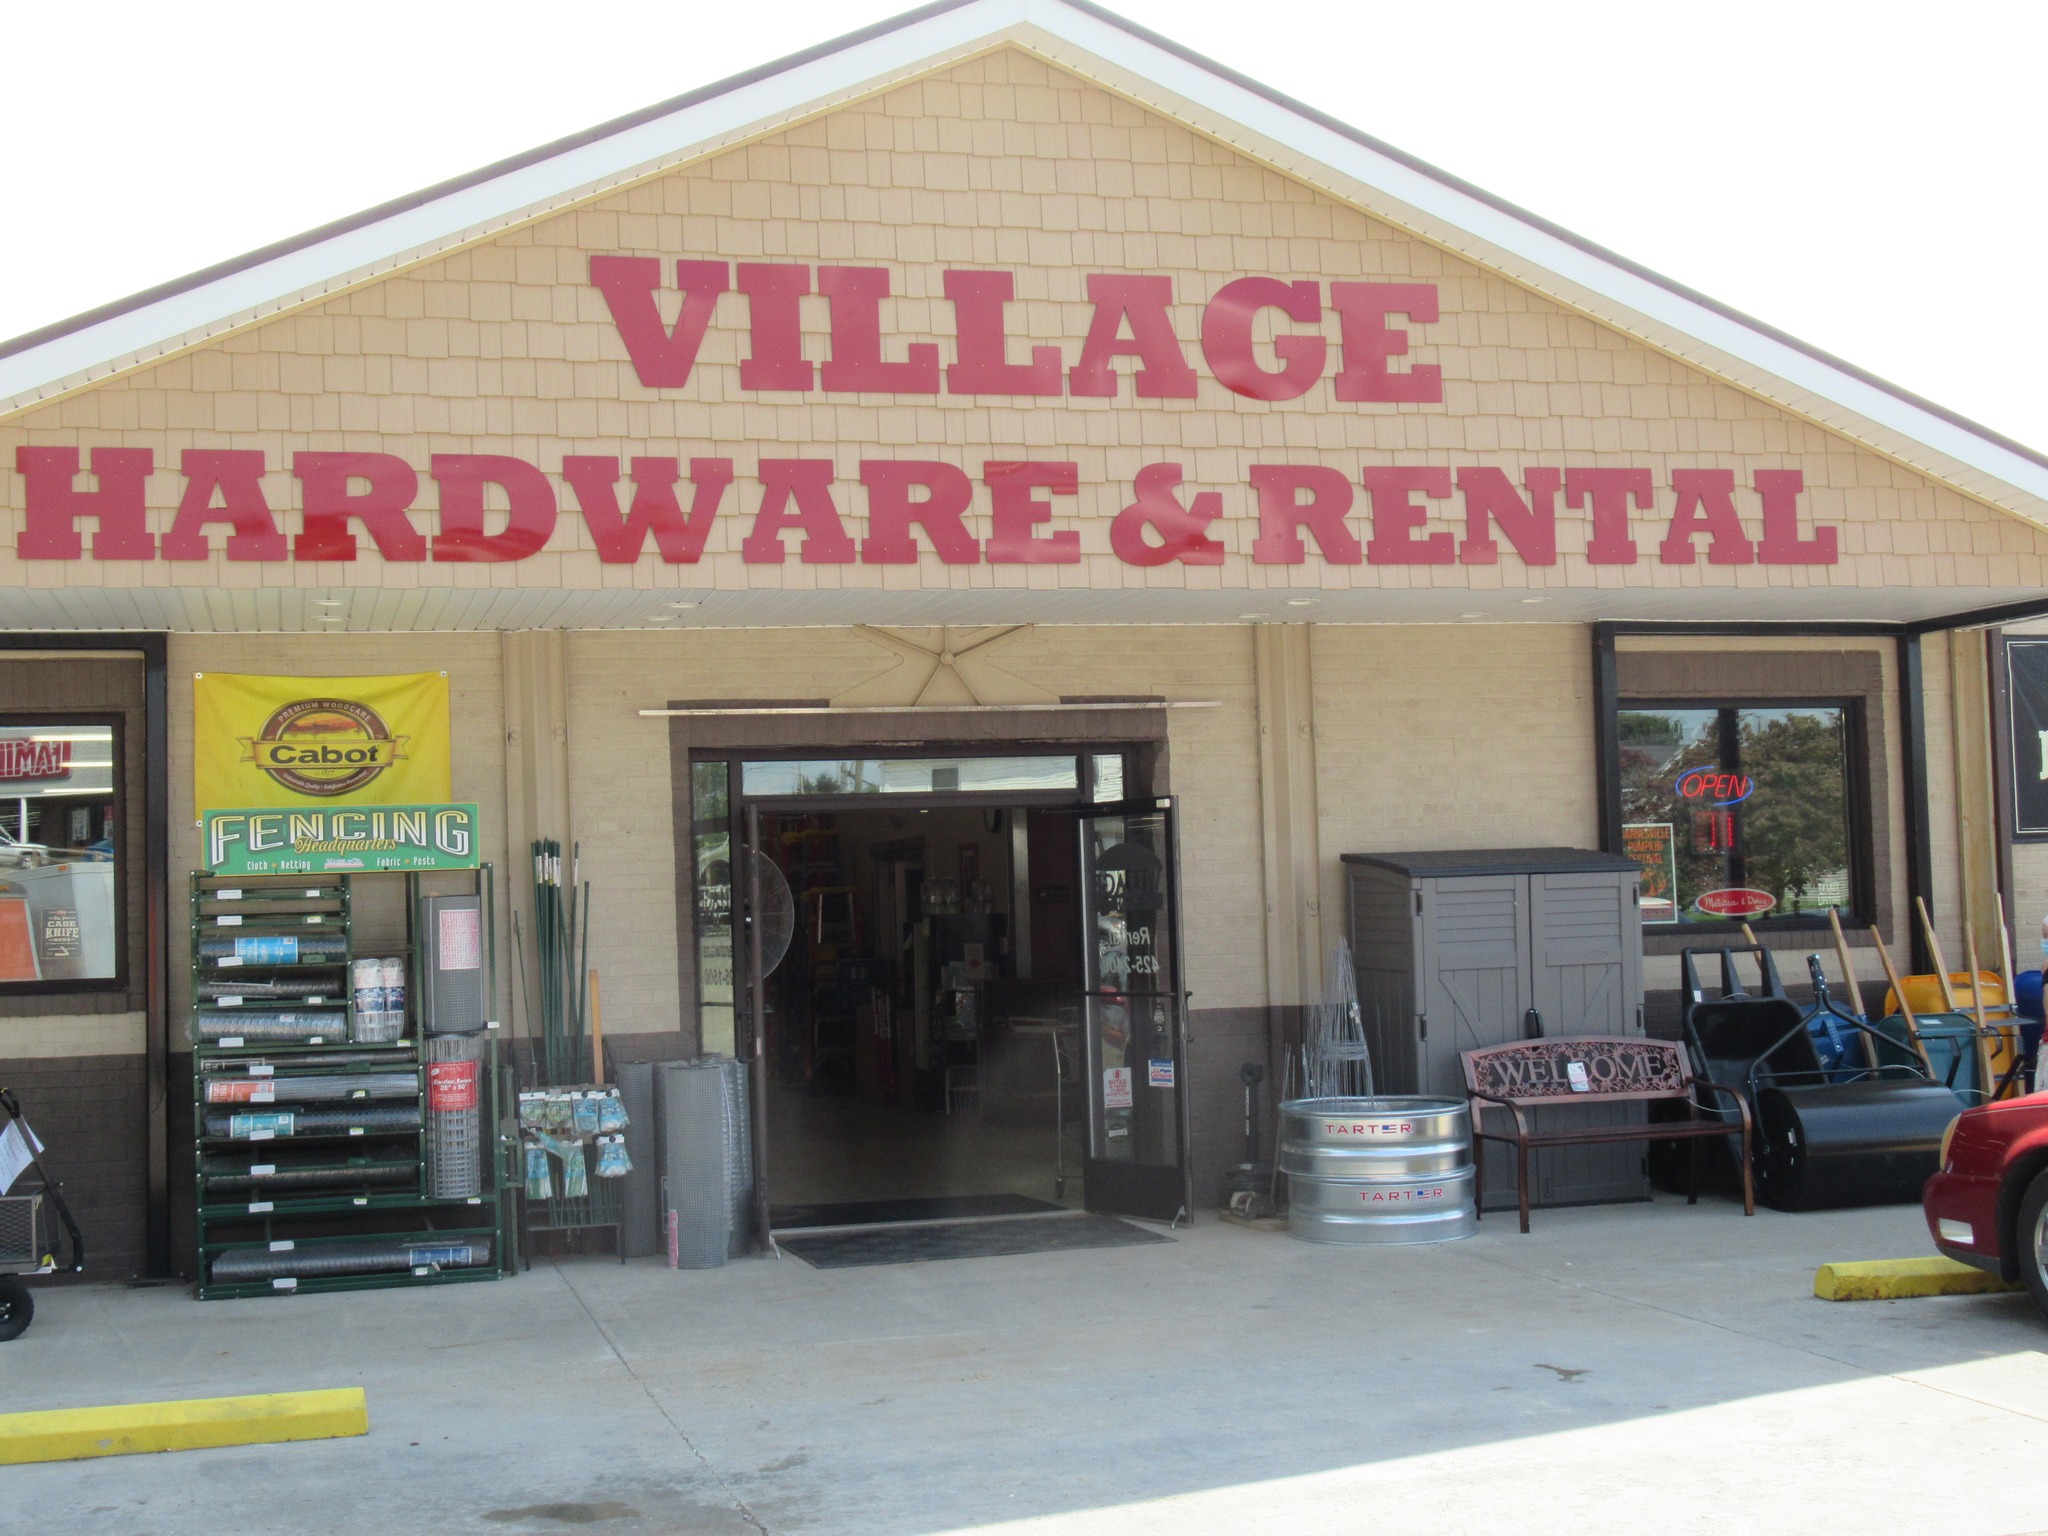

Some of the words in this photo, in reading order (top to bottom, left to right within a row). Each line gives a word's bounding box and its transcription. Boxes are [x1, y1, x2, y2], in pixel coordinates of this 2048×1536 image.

[590, 255, 1442, 402] VILLAGE
[15, 445, 1080, 564] HARDWARE
[1110, 462, 1225, 566] &
[1249, 463, 1838, 567] RENTAL
[278, 702, 319, 723] PREMIUM
[322, 702, 372, 722] WOODCARE
[269, 744, 378, 764] Cabot
[1682, 774, 1748, 798] OPEN
[211, 809, 471, 867] FENCING
[1623, 827, 1670, 840] ARNESVILLE
[294, 835, 397, 855] Headquarters
[247, 861, 268, 871] Cloth
[280, 860, 311, 871] Netting
[377, 857, 401, 867] Fabric
[413, 856, 436, 866] Posts
[1704, 897, 1739, 909] Melissa
[1747, 896, 1768, 907] Doug
[47, 920, 77, 928] CASE
[45, 927, 80, 939] KNIFE
[1325, 1123, 1412, 1134] TARTER
[1358, 1188, 1443, 1201] TARTER
